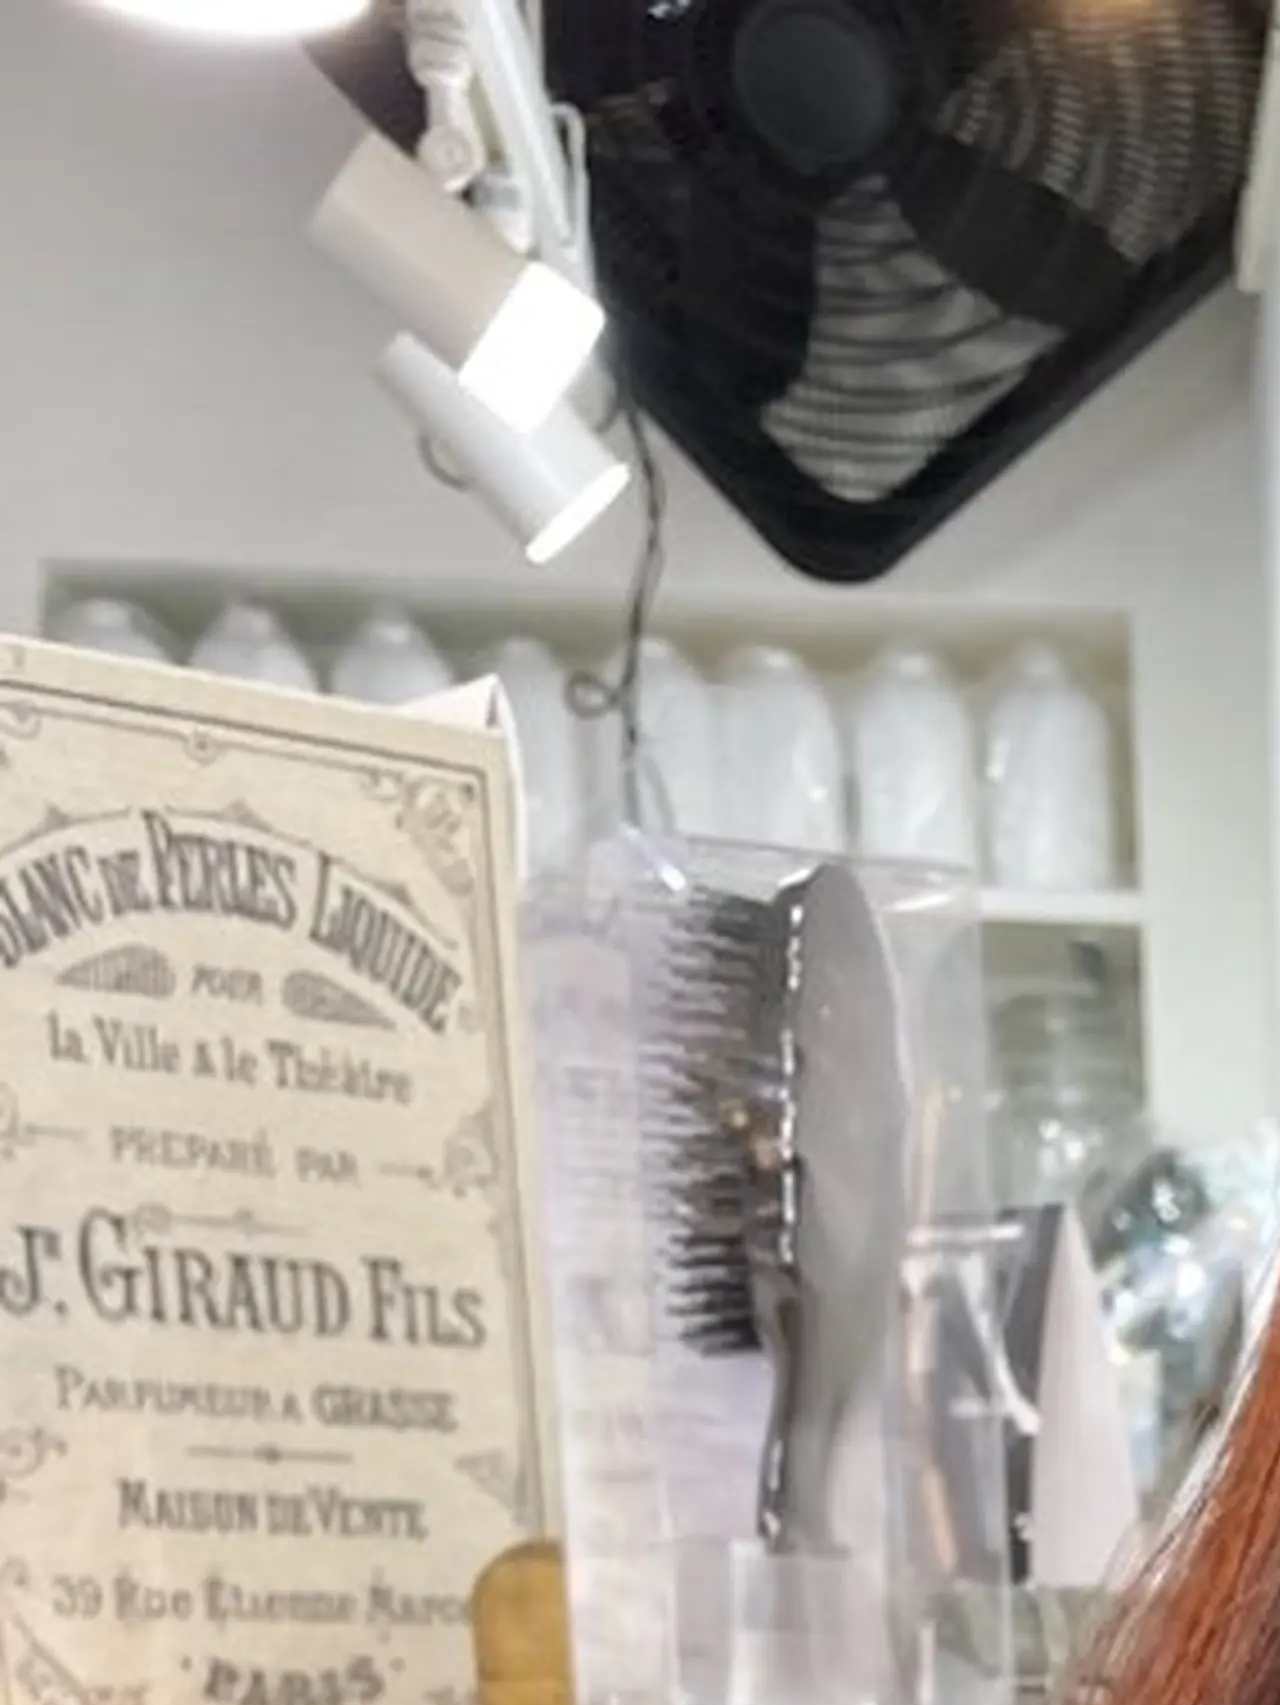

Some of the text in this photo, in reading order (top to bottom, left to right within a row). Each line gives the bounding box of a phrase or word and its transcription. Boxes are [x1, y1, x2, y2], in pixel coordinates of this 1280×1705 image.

[140, 810, 297, 931] PERLES
[308, 851, 462, 1033] LIQUIDE
[93, 1012, 180, 1073] Ville
[220, 1031, 259, 1087] le
[78, 1196, 351, 1338] GIRAUD
[361, 1255, 487, 1350] FILS
[118, 1477, 258, 1530] MAISON
